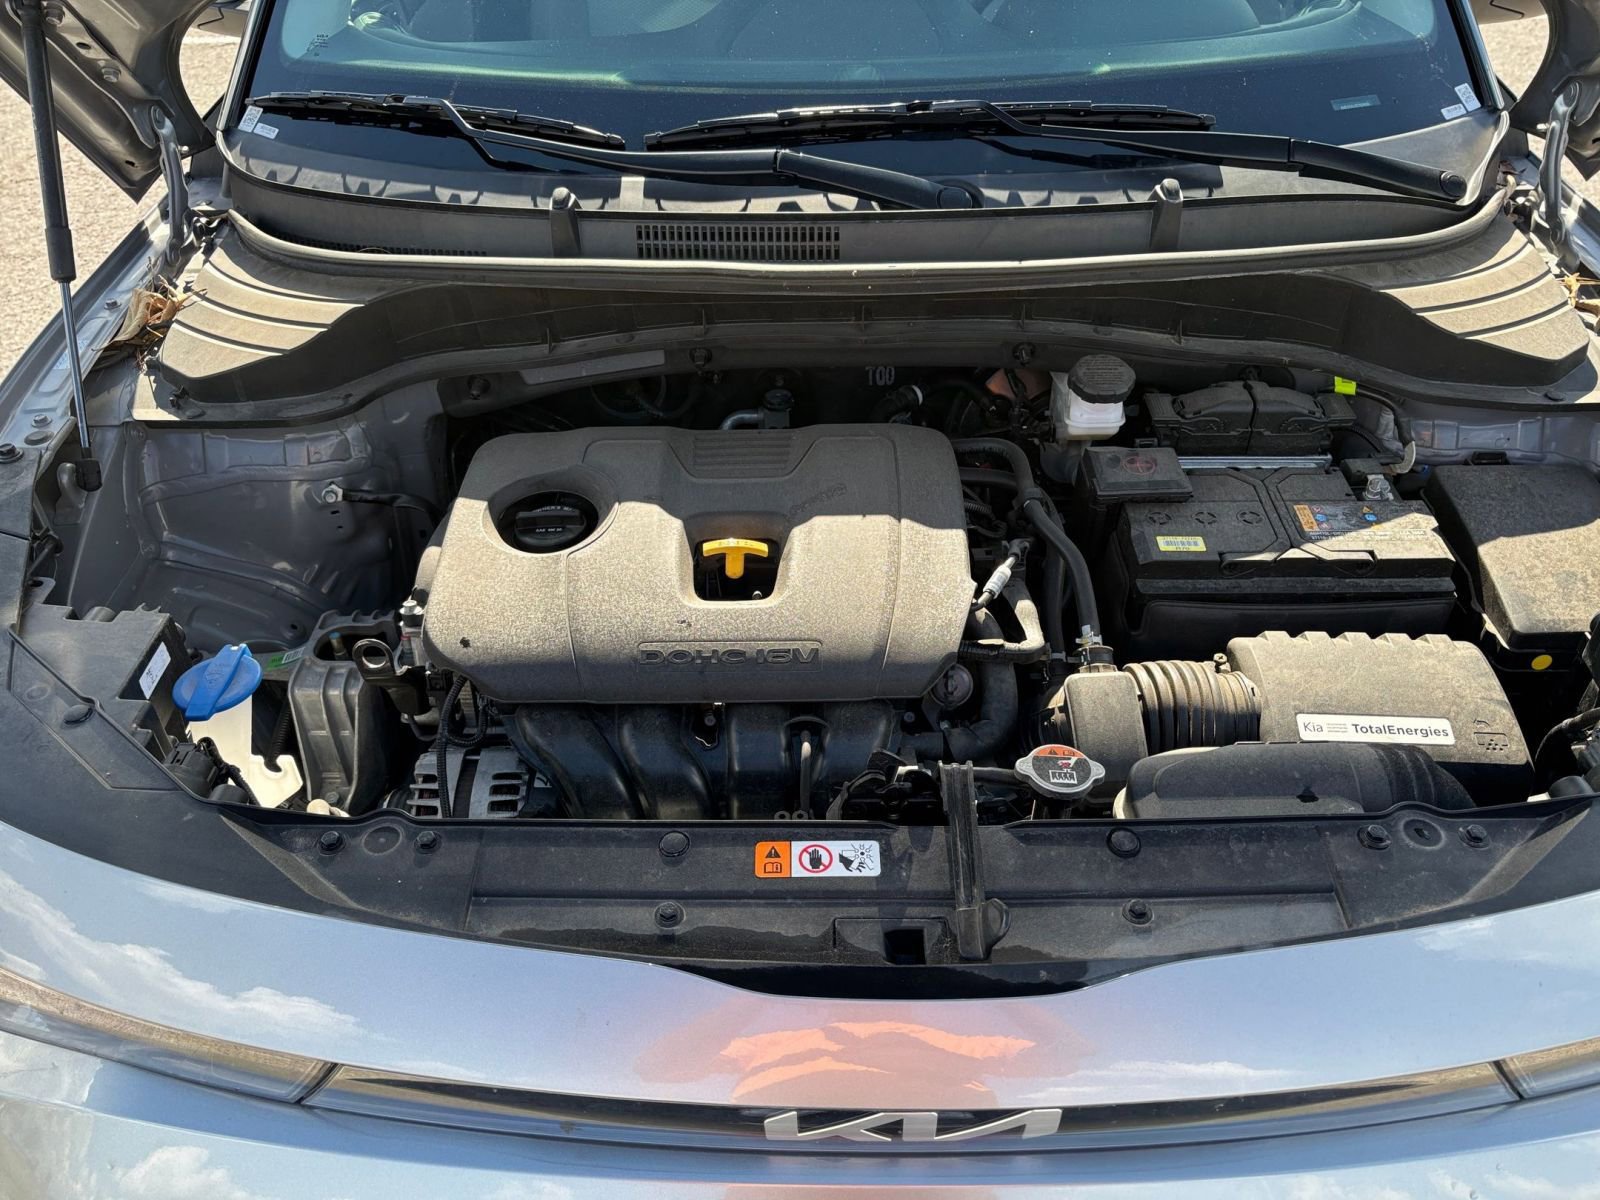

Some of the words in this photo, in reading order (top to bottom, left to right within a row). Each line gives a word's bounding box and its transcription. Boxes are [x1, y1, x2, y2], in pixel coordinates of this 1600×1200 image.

[639, 648, 748, 666] DOHC
[755, 647, 820, 665] 16V
[1303, 721, 1324, 733] Kia
[1352, 723, 1450, 738] TotalEnergies
[763, 1107, 1064, 1143] KIA
